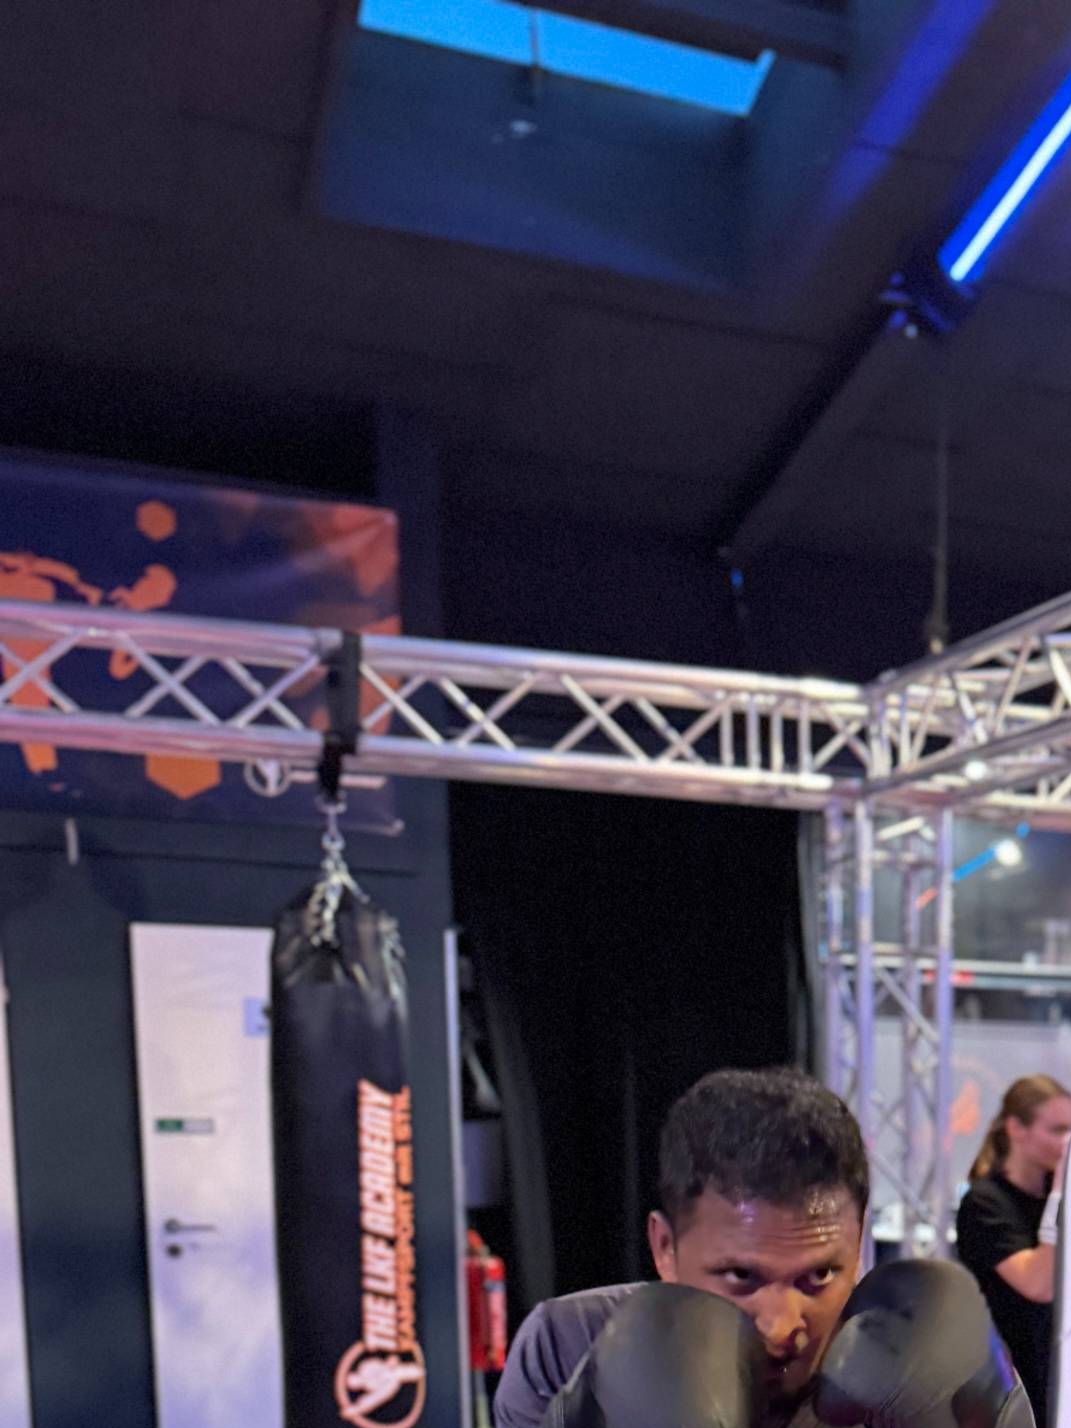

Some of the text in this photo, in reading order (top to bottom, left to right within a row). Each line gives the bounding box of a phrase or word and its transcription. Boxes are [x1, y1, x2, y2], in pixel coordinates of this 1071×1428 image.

[358, 1079, 399, 1351] THE LKF ACADEMY
